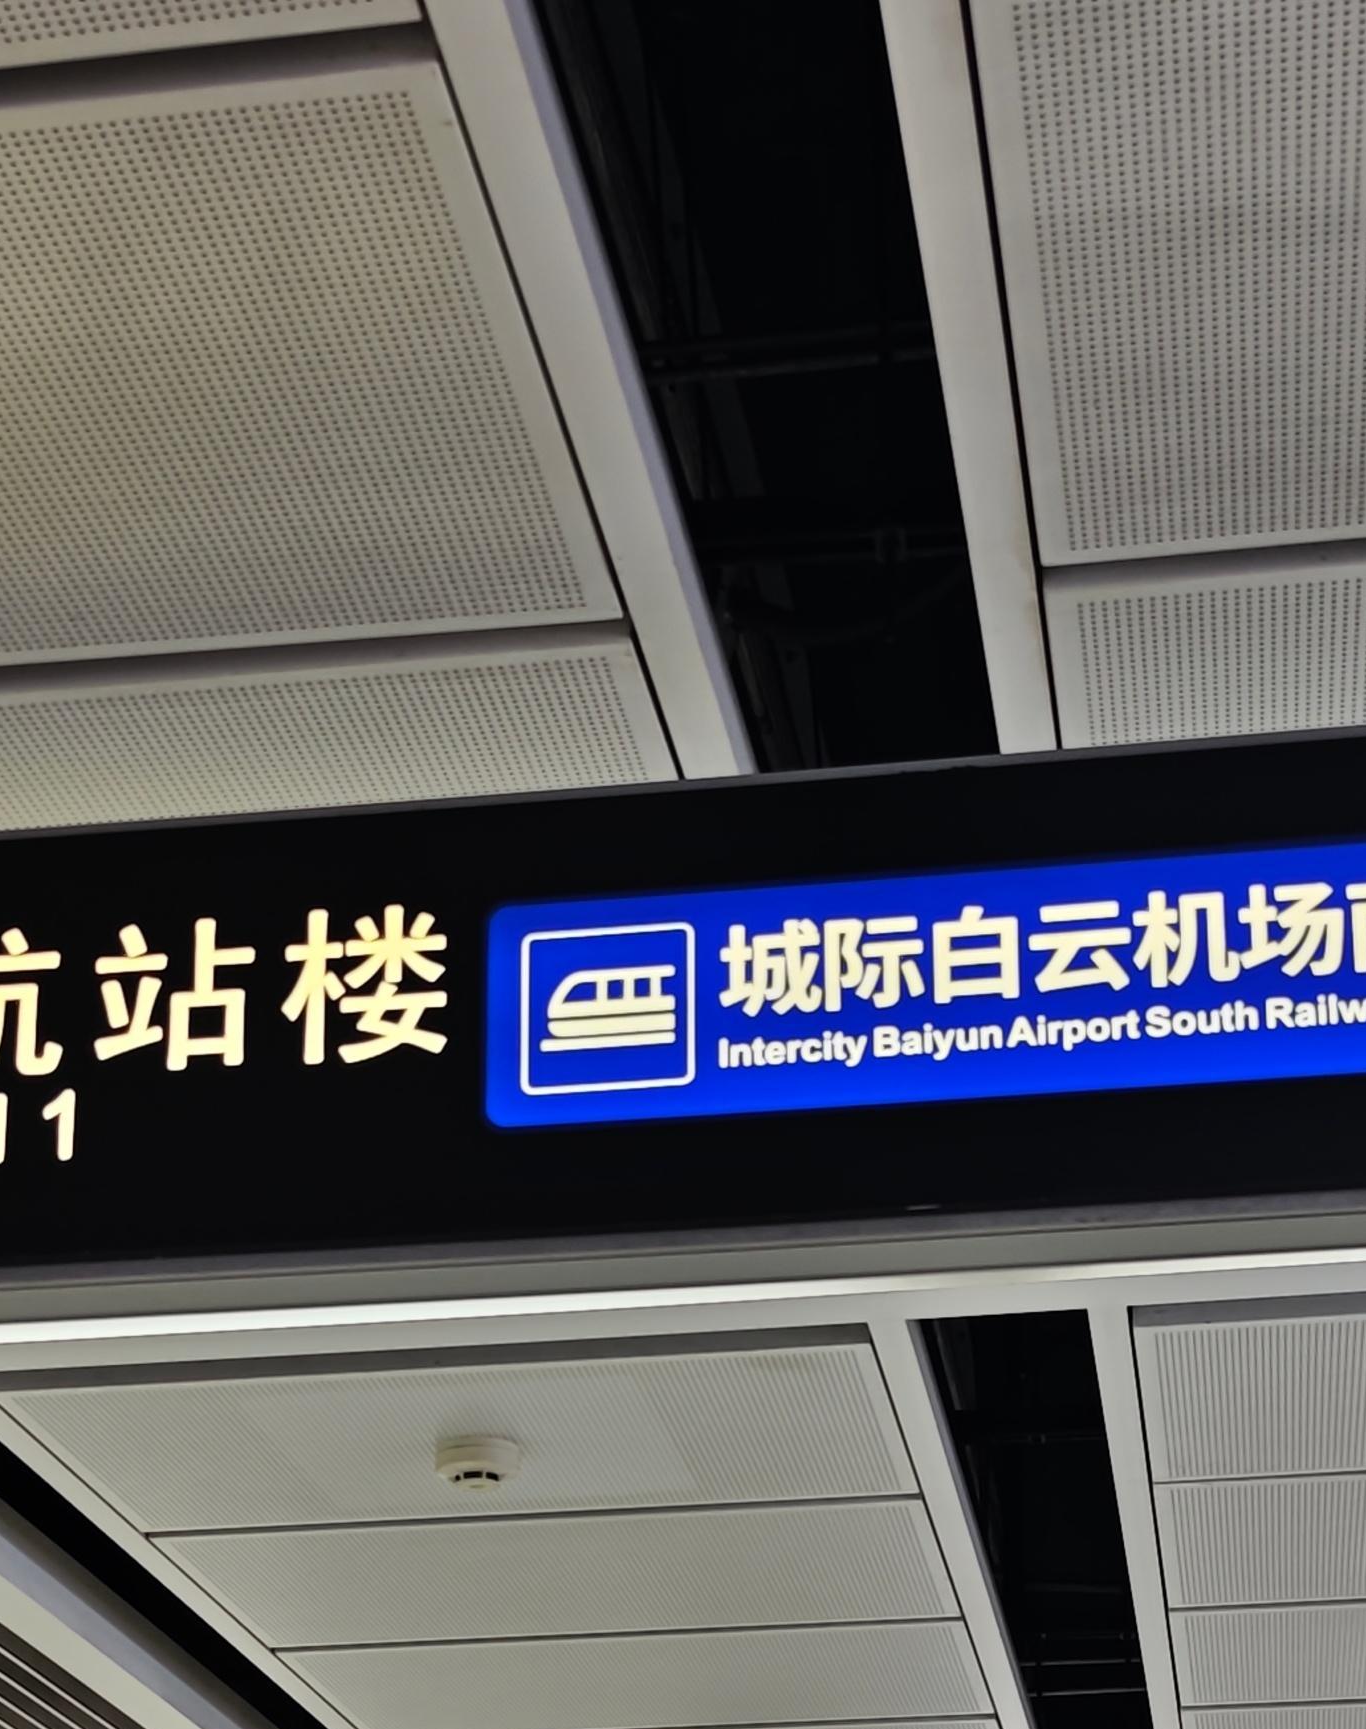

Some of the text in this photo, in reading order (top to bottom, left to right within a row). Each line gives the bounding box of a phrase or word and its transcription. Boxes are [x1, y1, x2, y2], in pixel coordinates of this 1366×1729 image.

[718, 1031, 867, 1068] Intercity
[873, 1022, 1003, 1060] Baiyun
[1006, 1010, 1141, 1051] Airport
[1144, 1000, 1260, 1038] South
[41, 1088, 76, 1162] 1
